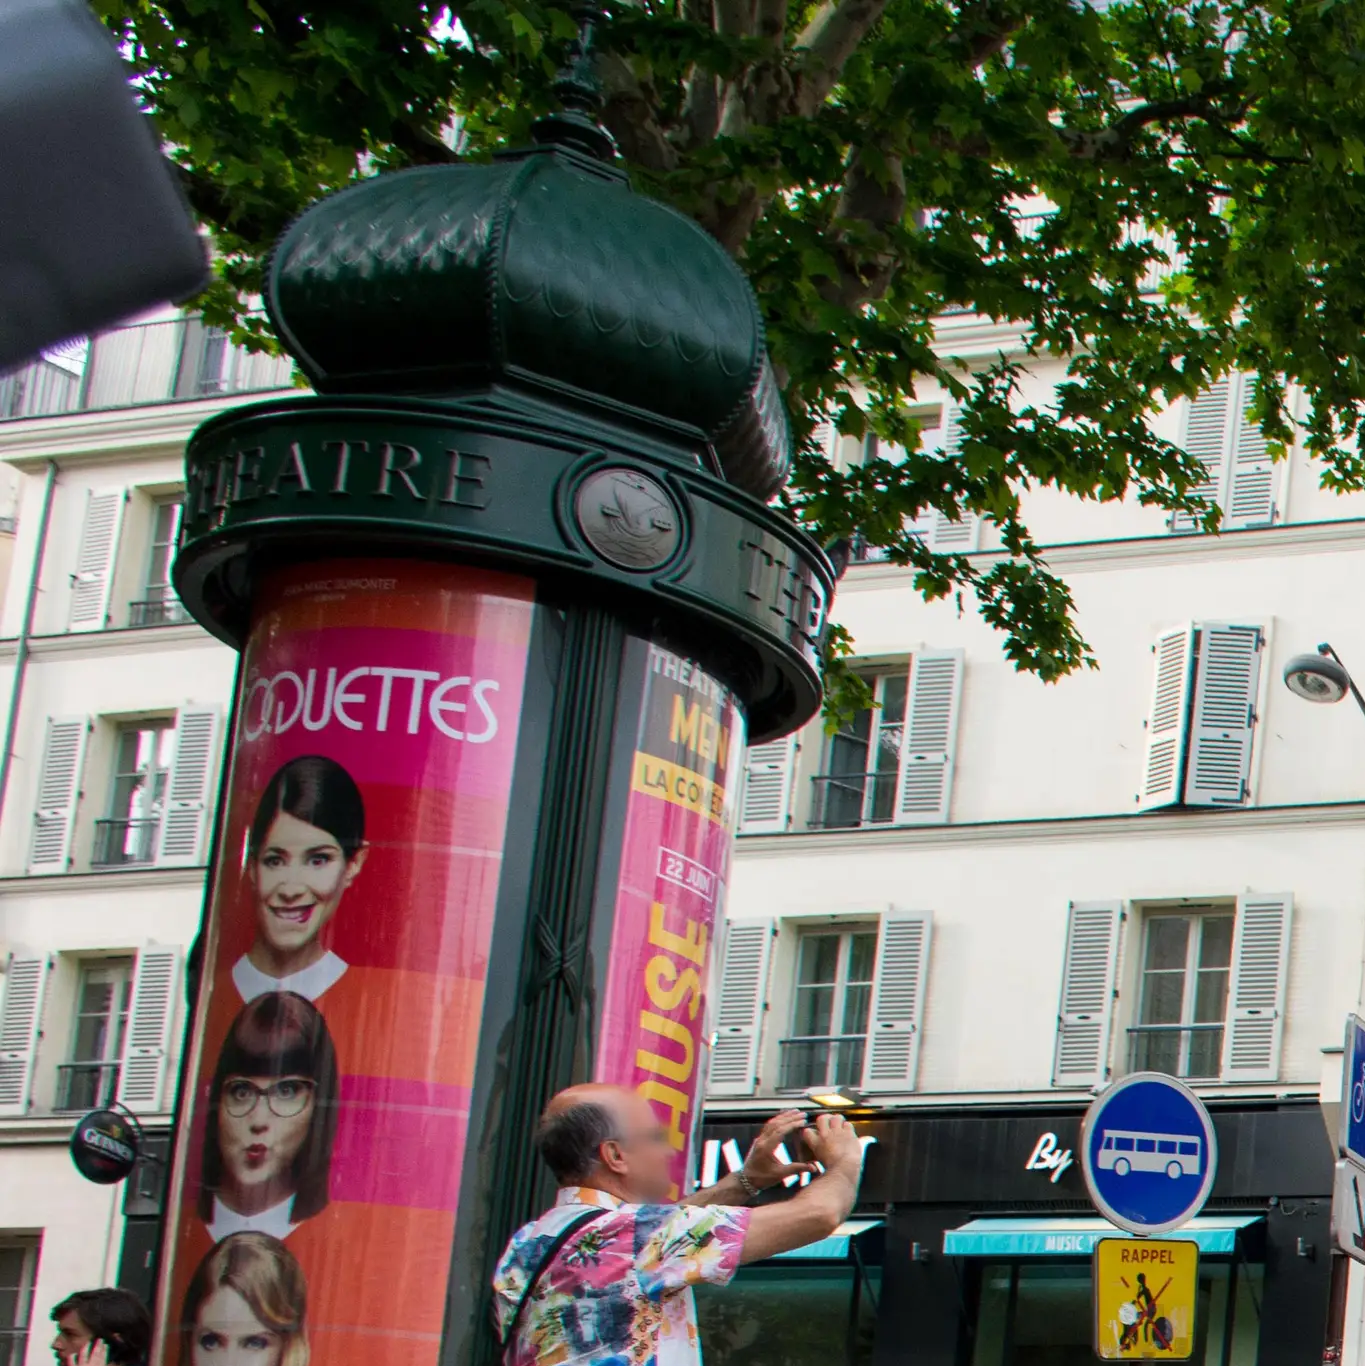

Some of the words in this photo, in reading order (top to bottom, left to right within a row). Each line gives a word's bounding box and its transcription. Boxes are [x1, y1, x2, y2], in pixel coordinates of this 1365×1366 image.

[244, 666, 499, 744] OQUETTES
[643, 763, 669, 794] LA
[665, 857, 686, 878] 22
[686, 865, 712, 894] JUIN
[1025, 1131, 1074, 1183] By
[1045, 1235, 1084, 1252] MUSIC
[1121, 1248, 1175, 1264] RAPPEL
